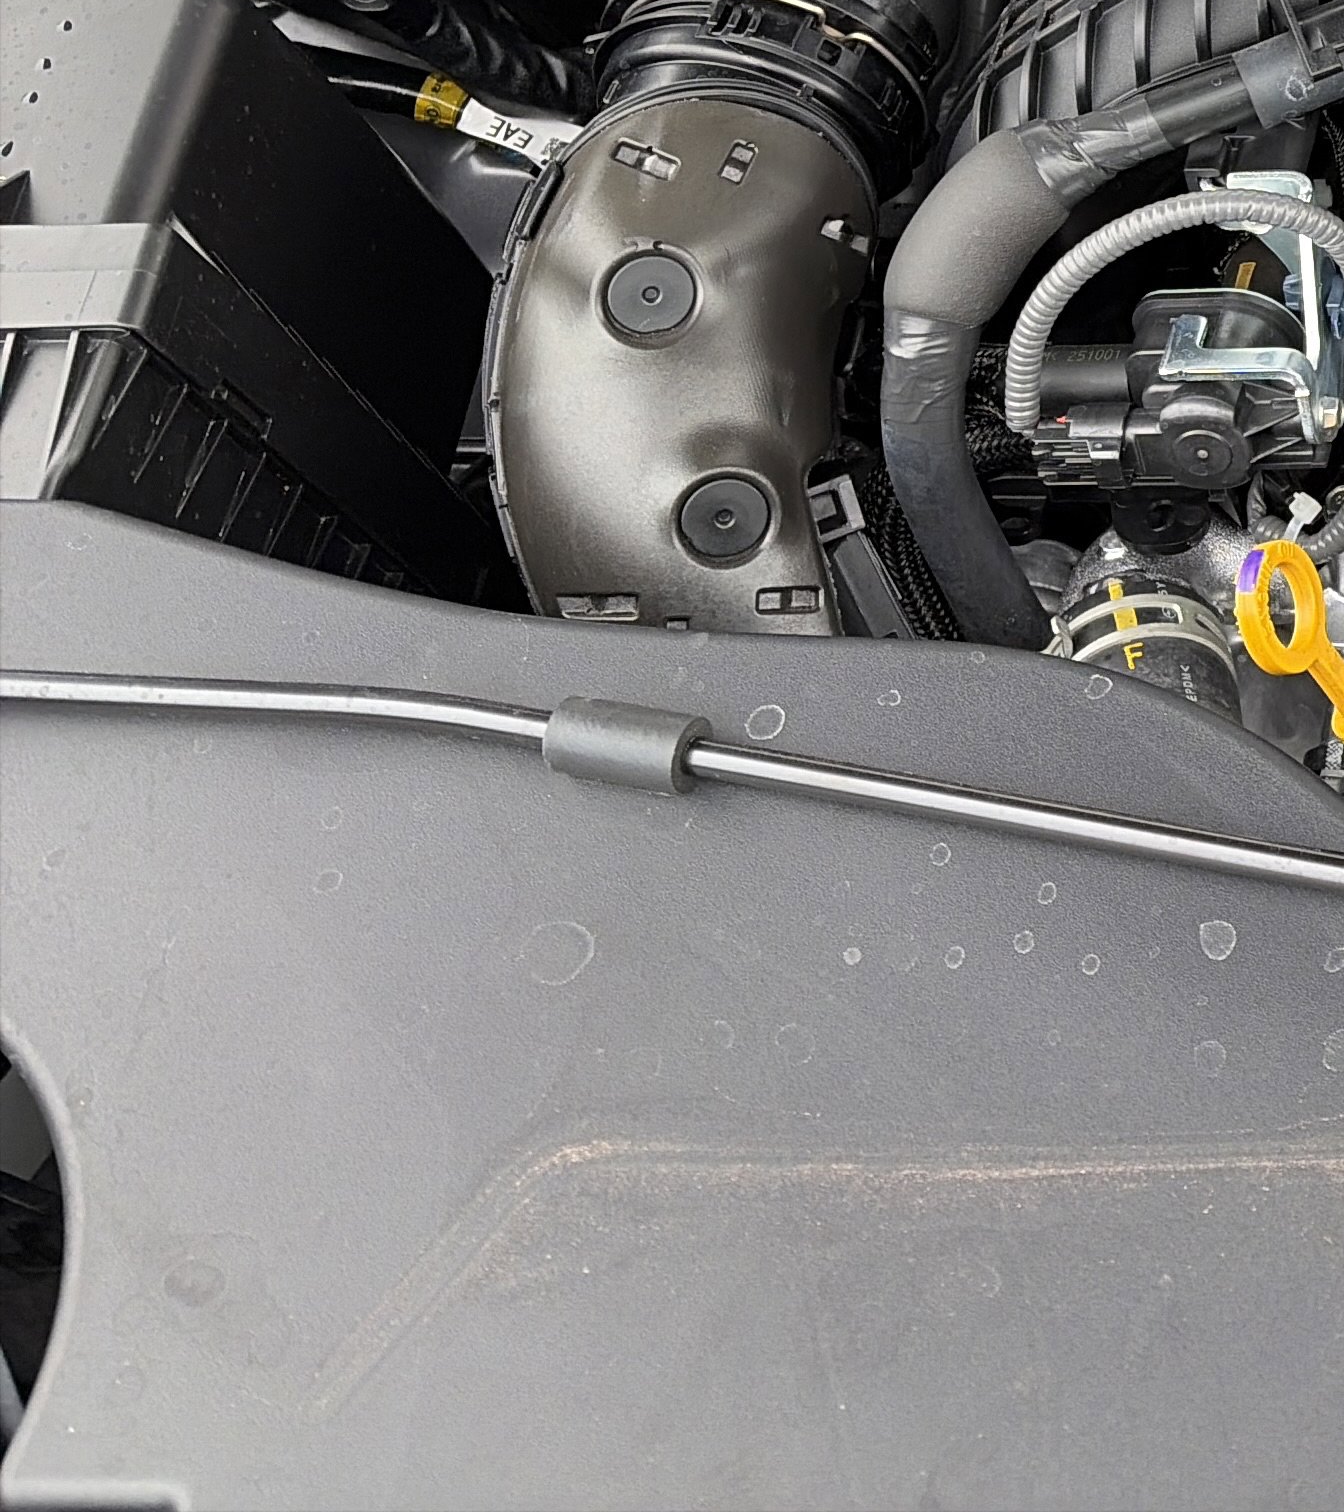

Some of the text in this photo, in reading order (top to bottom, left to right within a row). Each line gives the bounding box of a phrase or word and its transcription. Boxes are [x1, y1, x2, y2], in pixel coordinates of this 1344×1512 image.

[486, 115, 534, 150] EAE
[1066, 349, 1121, 362] 251001
[1123, 641, 1144, 671] F
